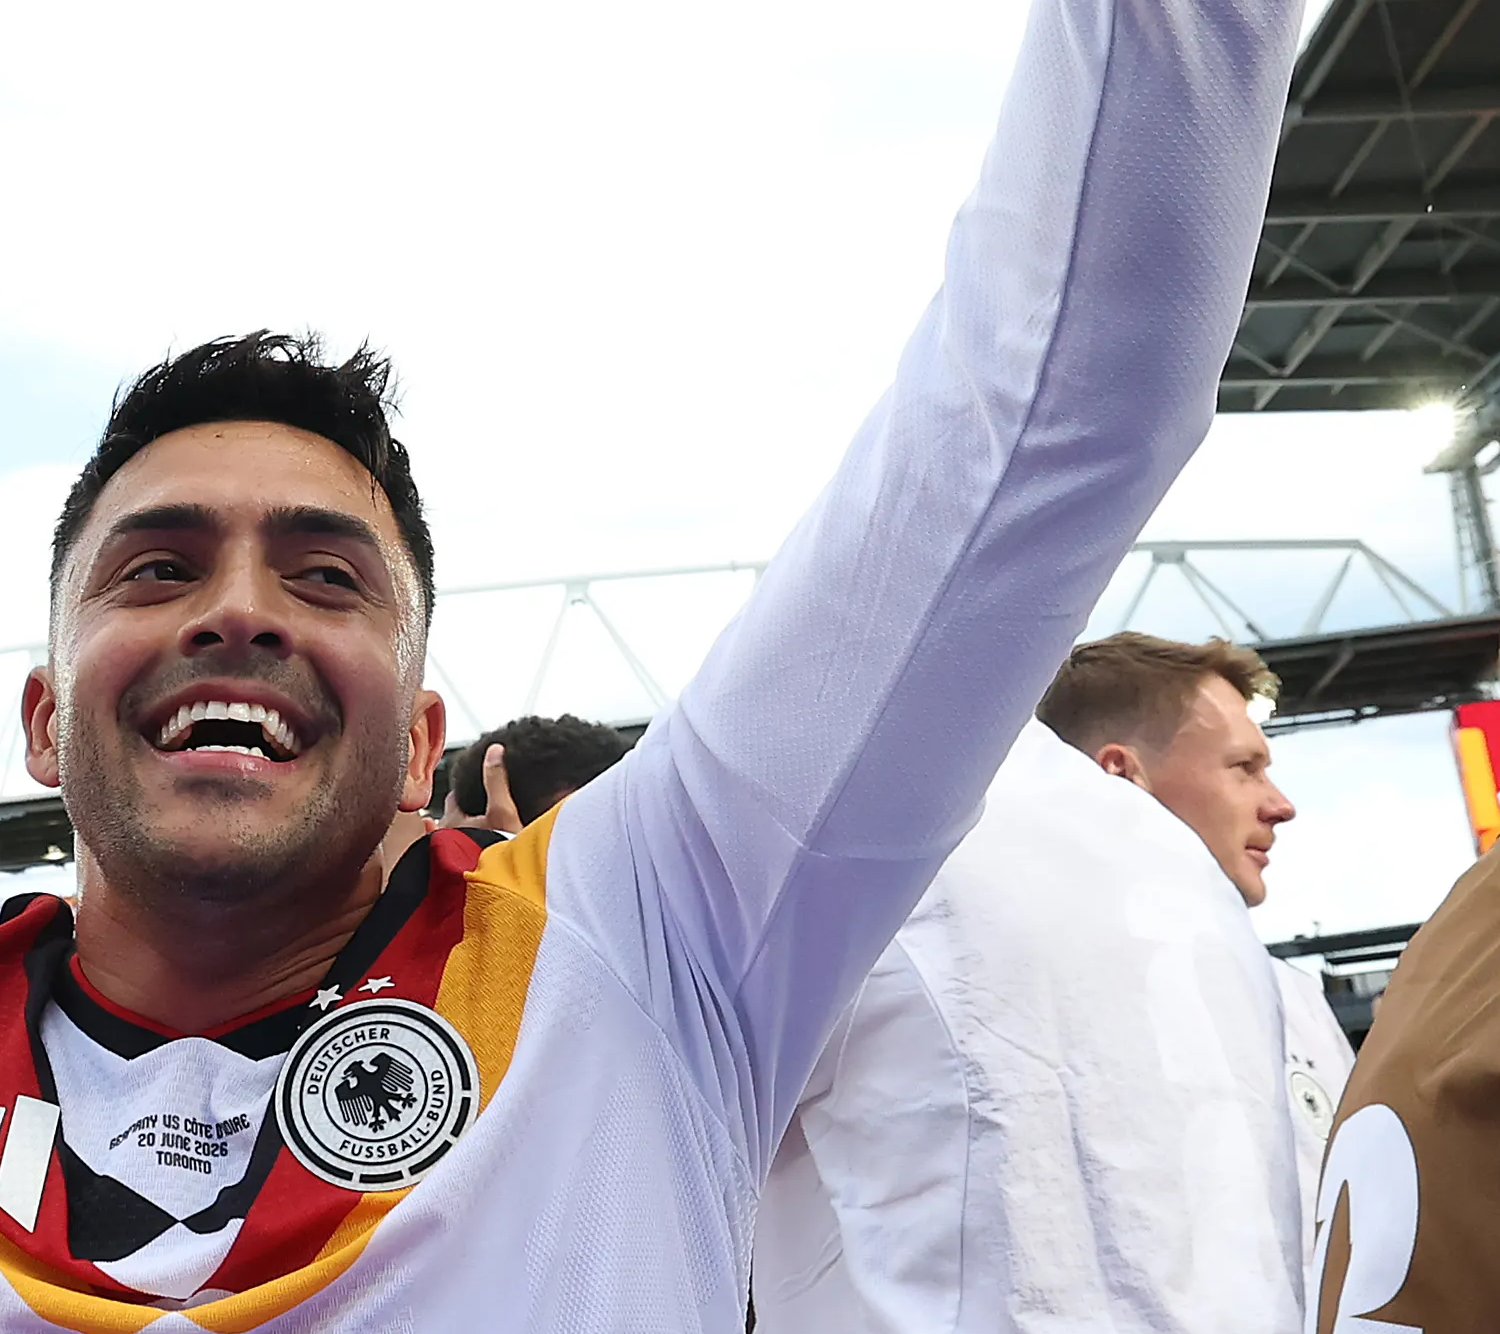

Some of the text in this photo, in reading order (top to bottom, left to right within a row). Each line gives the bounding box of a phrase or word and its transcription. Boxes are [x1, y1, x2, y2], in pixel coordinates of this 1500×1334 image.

[307, 1027, 391, 1095] DEUTSCHER
[338, 1069, 445, 1159] FUSSBALL-BUND
[138, 1132, 228, 1157] 20 JUNE 2026
[156, 1151, 212, 1174] TORONTO
